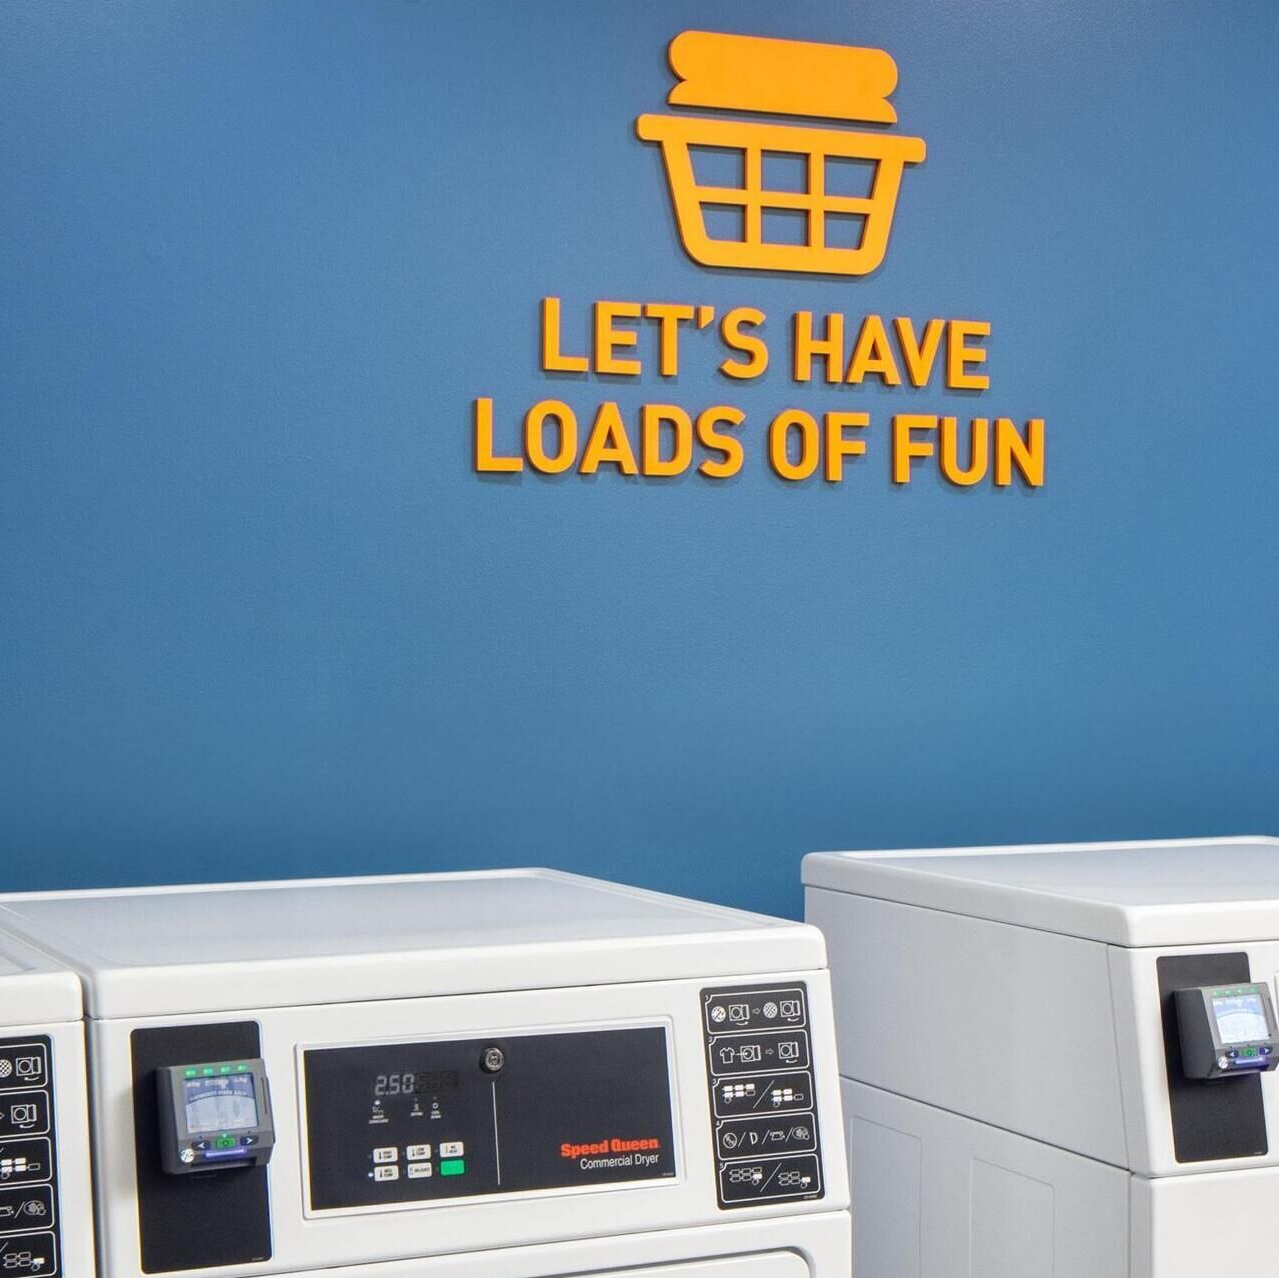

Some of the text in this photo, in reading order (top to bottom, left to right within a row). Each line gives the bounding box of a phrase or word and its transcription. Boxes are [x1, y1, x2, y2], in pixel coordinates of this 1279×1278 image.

[540, 296, 991, 390] LET'S HAVE
[474, 397, 1044, 487] LOADS OF FUN
[561, 1138, 659, 1159] Speed Queen
[580, 1153, 659, 1170] Commercial Dryer
